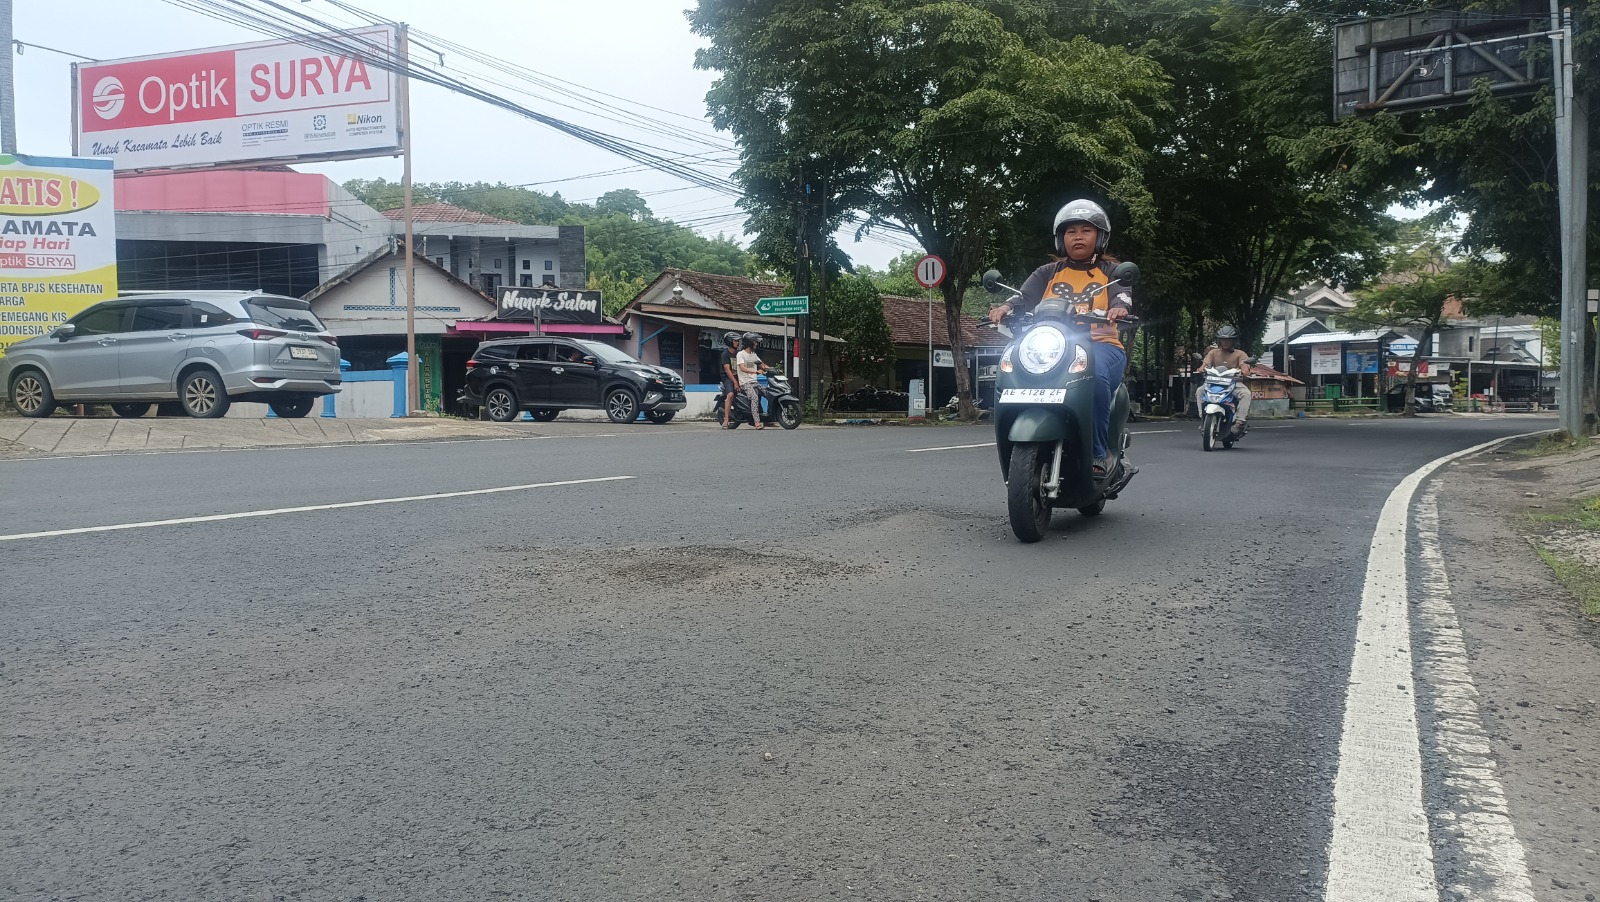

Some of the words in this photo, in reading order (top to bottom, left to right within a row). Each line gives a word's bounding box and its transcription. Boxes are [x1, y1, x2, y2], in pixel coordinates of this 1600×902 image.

[138, 69, 229, 120] Optik
[250, 54, 372, 102] SURYA
[356, 114, 382, 125] Nikon
[242, 122, 264, 132] OPTIK
[265, 120, 289, 130] RESMI
[92, 141, 120, 156] Untuk
[123, 139, 168, 153] Kacamata
[171, 133, 197, 148] Lebih
[200, 131, 223, 146] Baik
[0, 219, 97, 236] AMATA
[33, 237, 71, 250] Hari
[27, 256, 74, 267] SURYA
[21, 282, 46, 293] BPJS
[48, 283, 103, 294] KESEHATAN
[502, 290, 553, 311] Nunuk
[553, 291, 598, 314] Salon
[0, 312, 48, 322] EMEGANG
[51, 312, 67, 322] KIS
[1251, 391, 1265, 399] POCI
